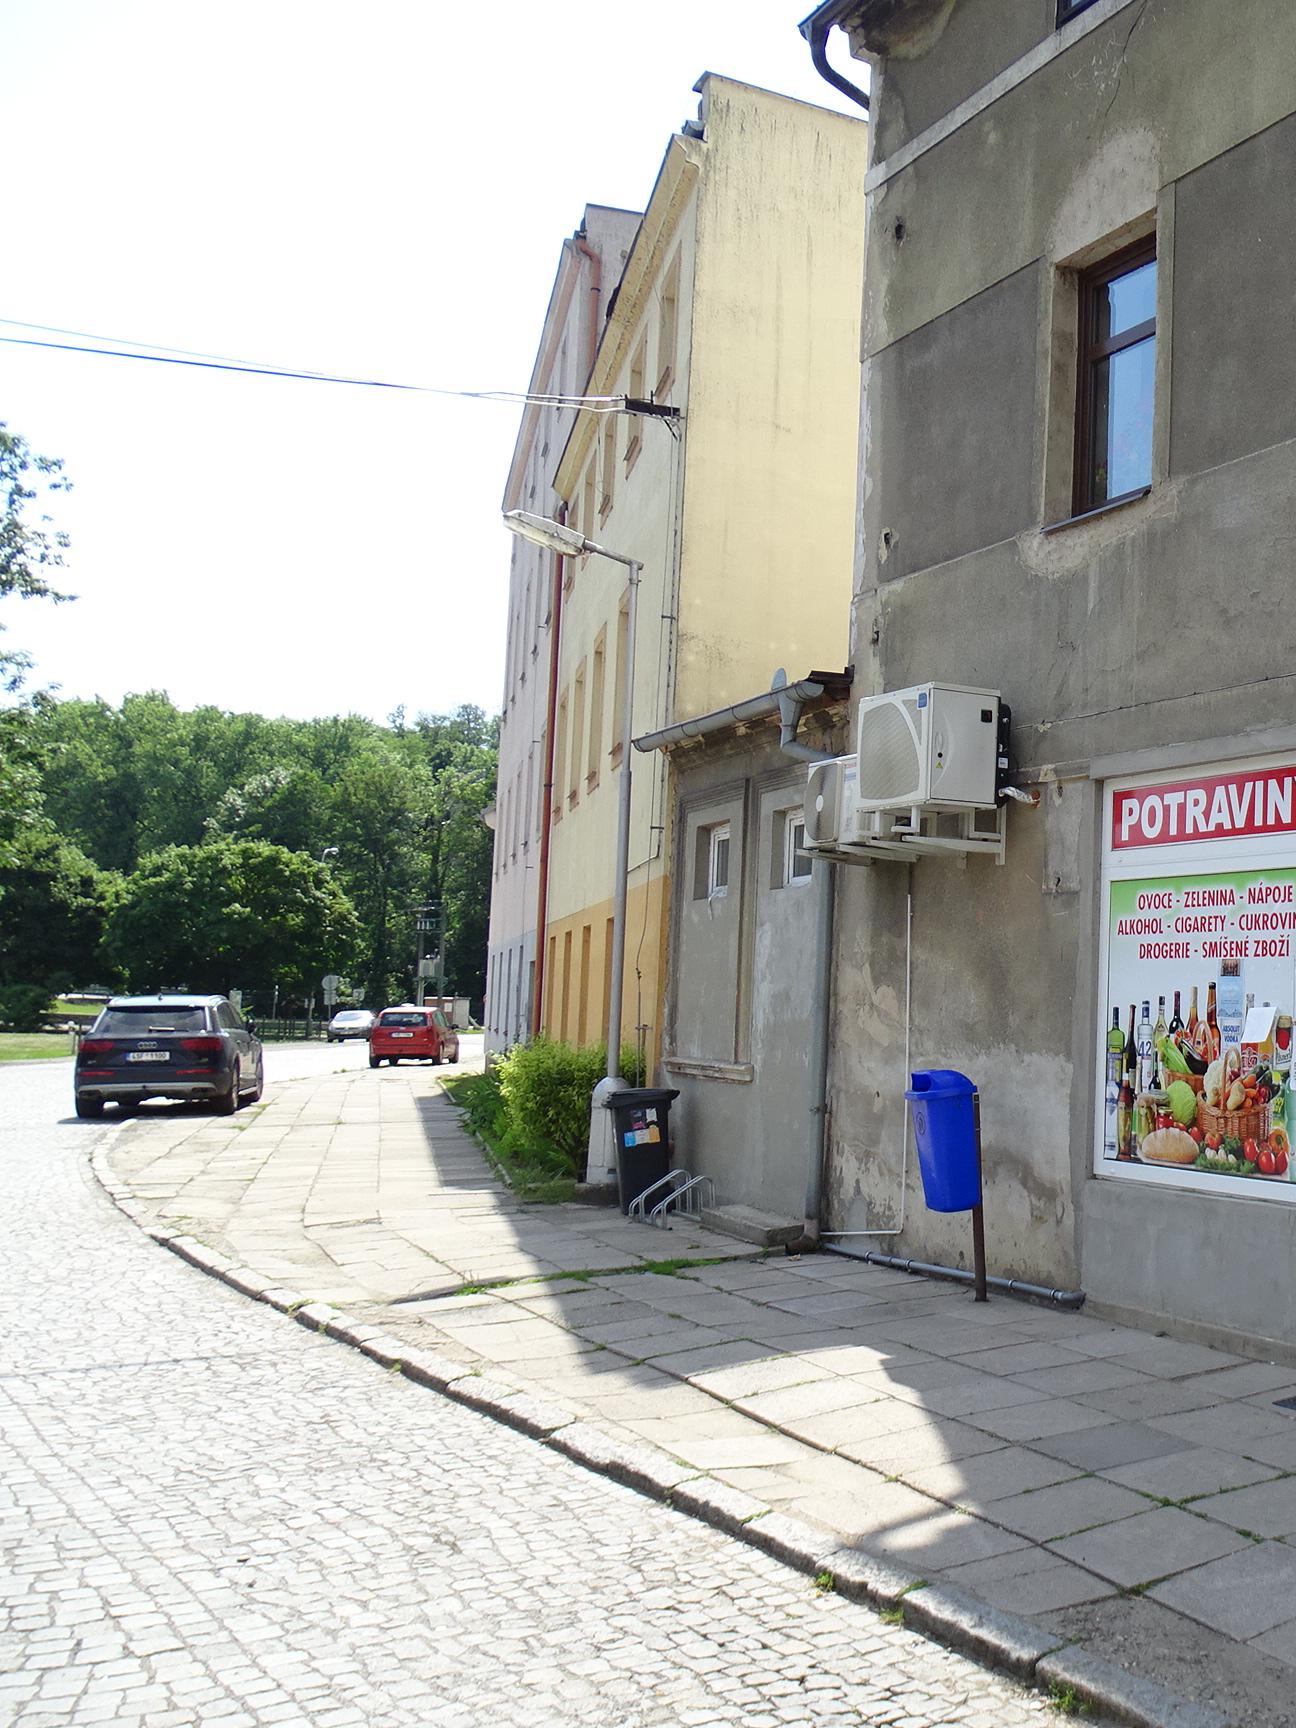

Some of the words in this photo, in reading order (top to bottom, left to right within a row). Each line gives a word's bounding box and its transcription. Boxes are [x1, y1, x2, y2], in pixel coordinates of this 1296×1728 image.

[1138, 892, 1173, 910] OVOCE
[1183, 888, 1235, 908] ZELENINA
[1247, 884, 1293, 905] NÁPOJE
[1117, 918, 1164, 936] ALKOHOL
[1174, 915, 1226, 934] CIGARETY
[1139, 941, 1191, 960] DROGERIE
[1202, 936, 1249, 959] SMÍŠENÉ
[1253, 934, 1291, 957] ZBOŽÍ
[1138, 1040, 1152, 1057] 42
